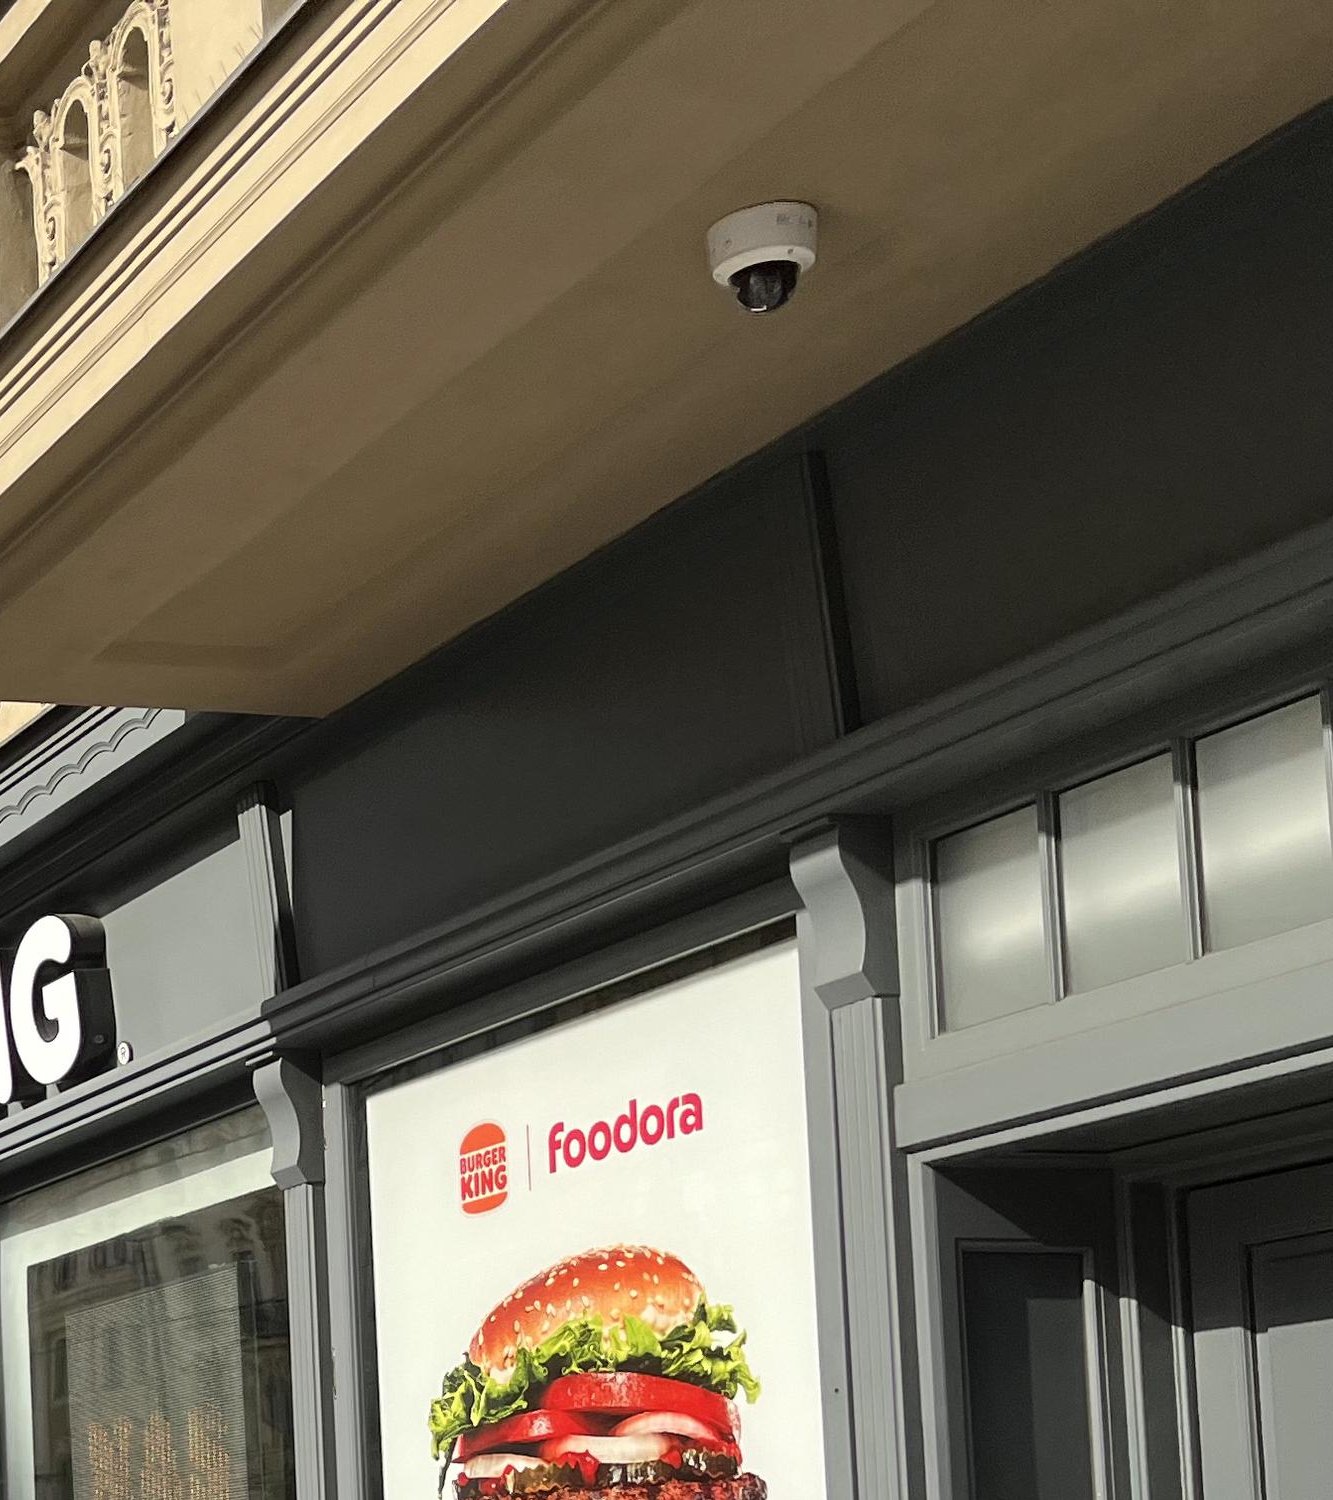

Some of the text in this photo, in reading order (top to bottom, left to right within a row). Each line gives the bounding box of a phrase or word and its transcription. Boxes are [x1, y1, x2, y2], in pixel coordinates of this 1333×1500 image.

[548, 1092, 704, 1174] foodora
[460, 1146, 507, 1175] BURGER
[460, 1165, 508, 1201] KING
